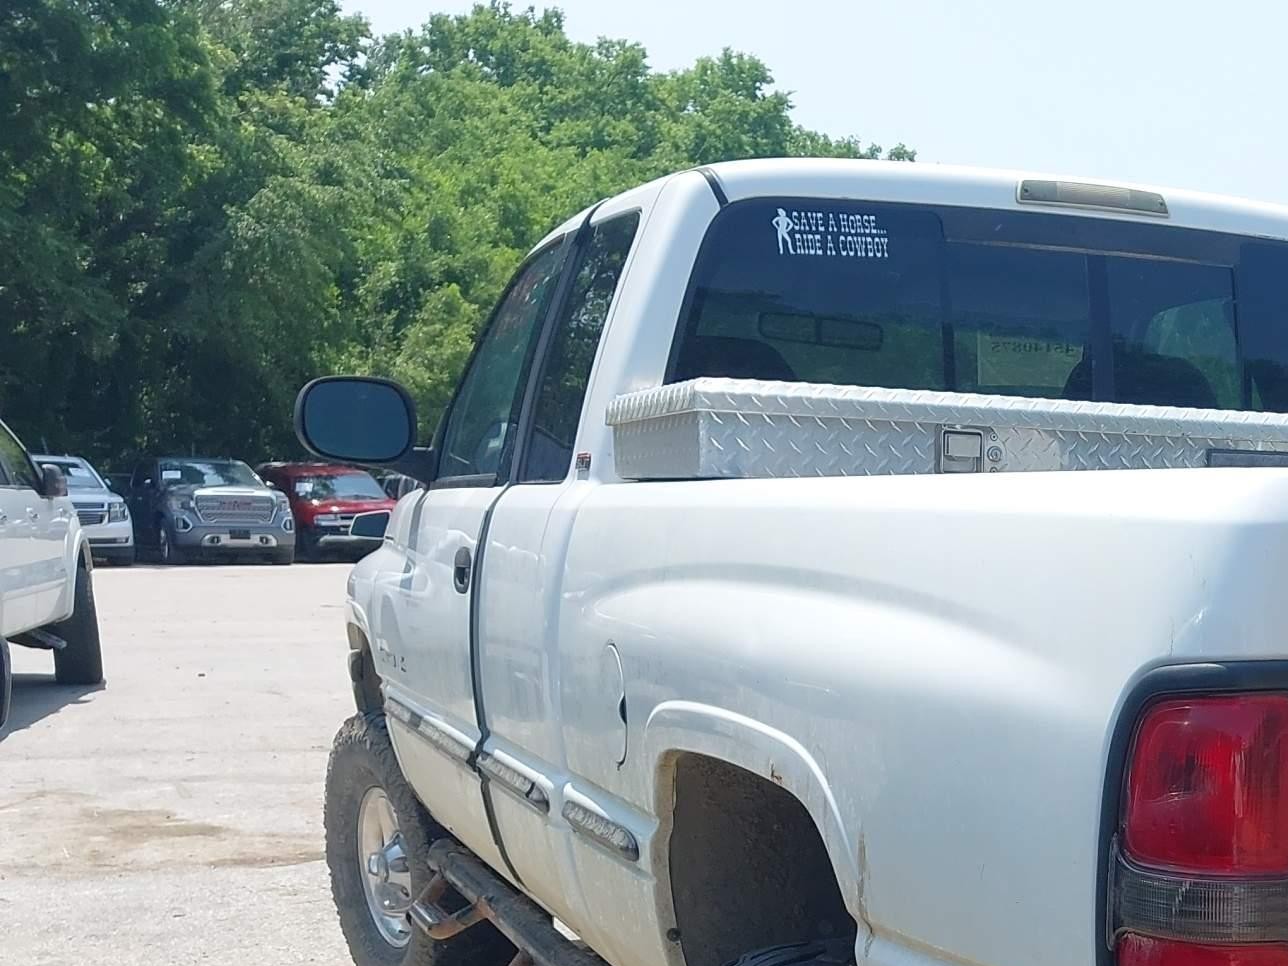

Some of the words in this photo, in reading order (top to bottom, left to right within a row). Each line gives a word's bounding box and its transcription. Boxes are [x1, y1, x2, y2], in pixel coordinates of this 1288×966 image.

[792, 211, 825, 232] SAVE
[828, 214, 838, 232] A
[839, 213, 888, 235] HORSE...
[794, 233, 823, 256] RIDE
[826, 234, 837, 256] A
[838, 235, 889, 258] COWBOY
